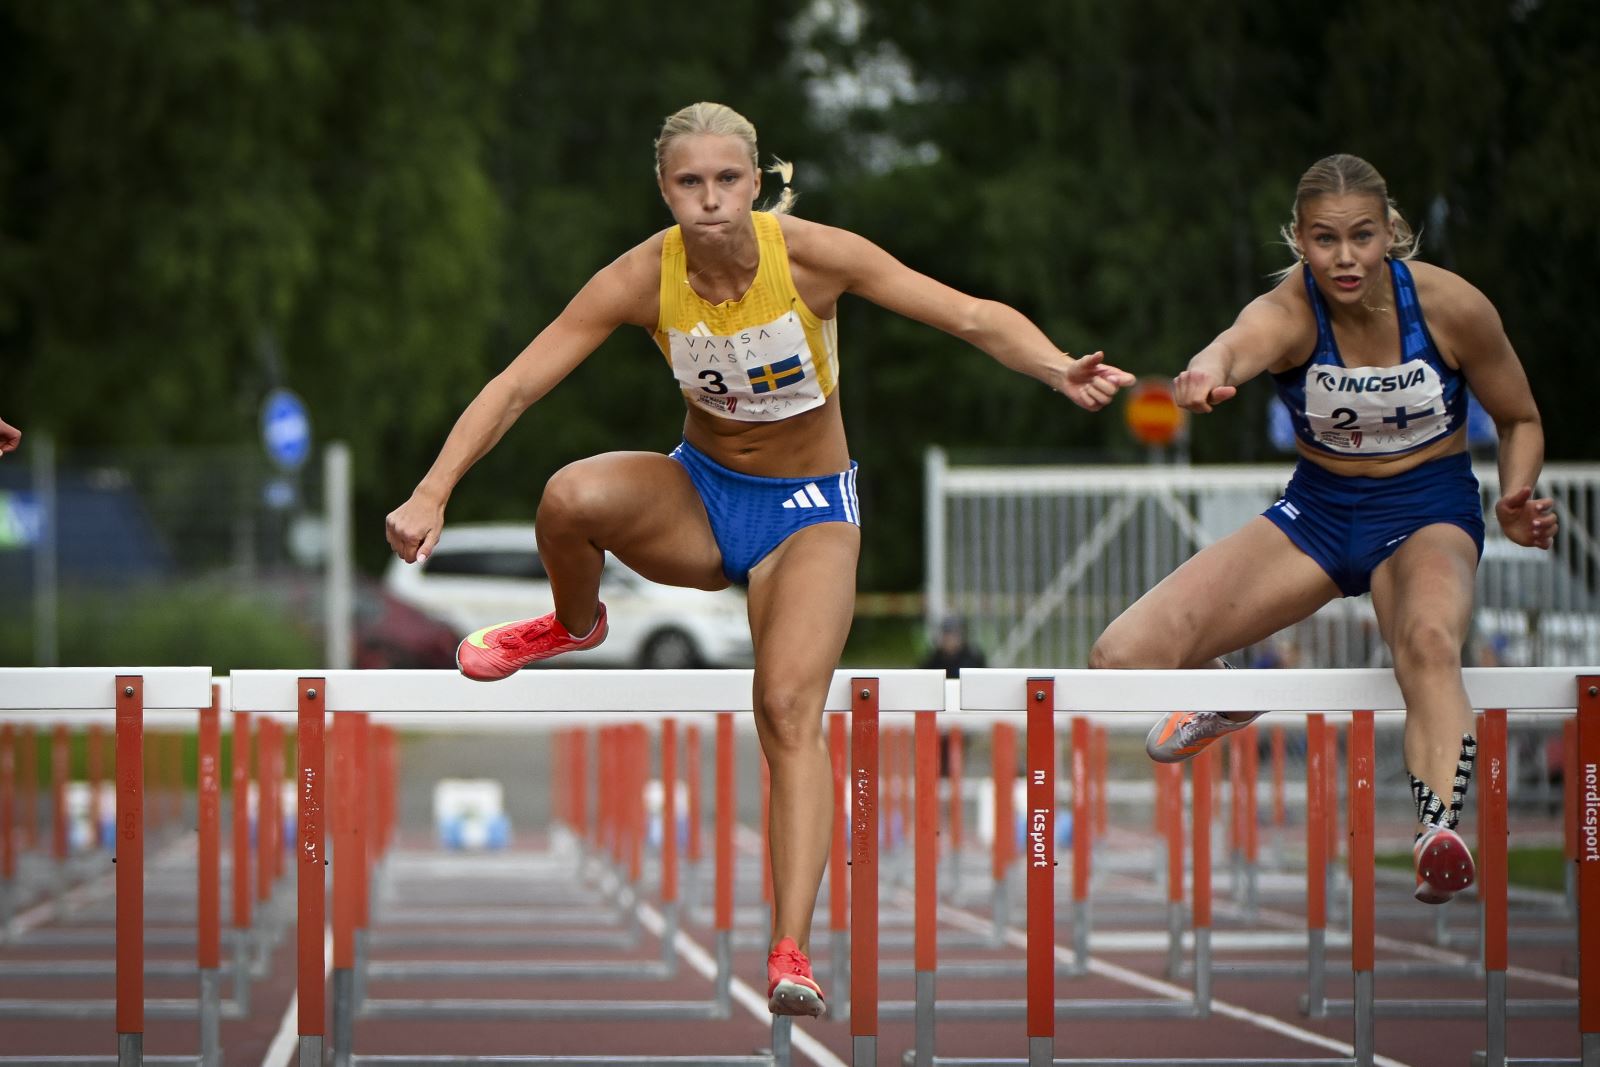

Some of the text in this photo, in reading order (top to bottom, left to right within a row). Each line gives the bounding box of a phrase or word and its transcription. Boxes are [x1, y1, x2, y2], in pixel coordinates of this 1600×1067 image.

[698, 369, 729, 395] 3
[1331, 407, 1360, 430] 2
[1582, 763, 1600, 862] nordicsport
